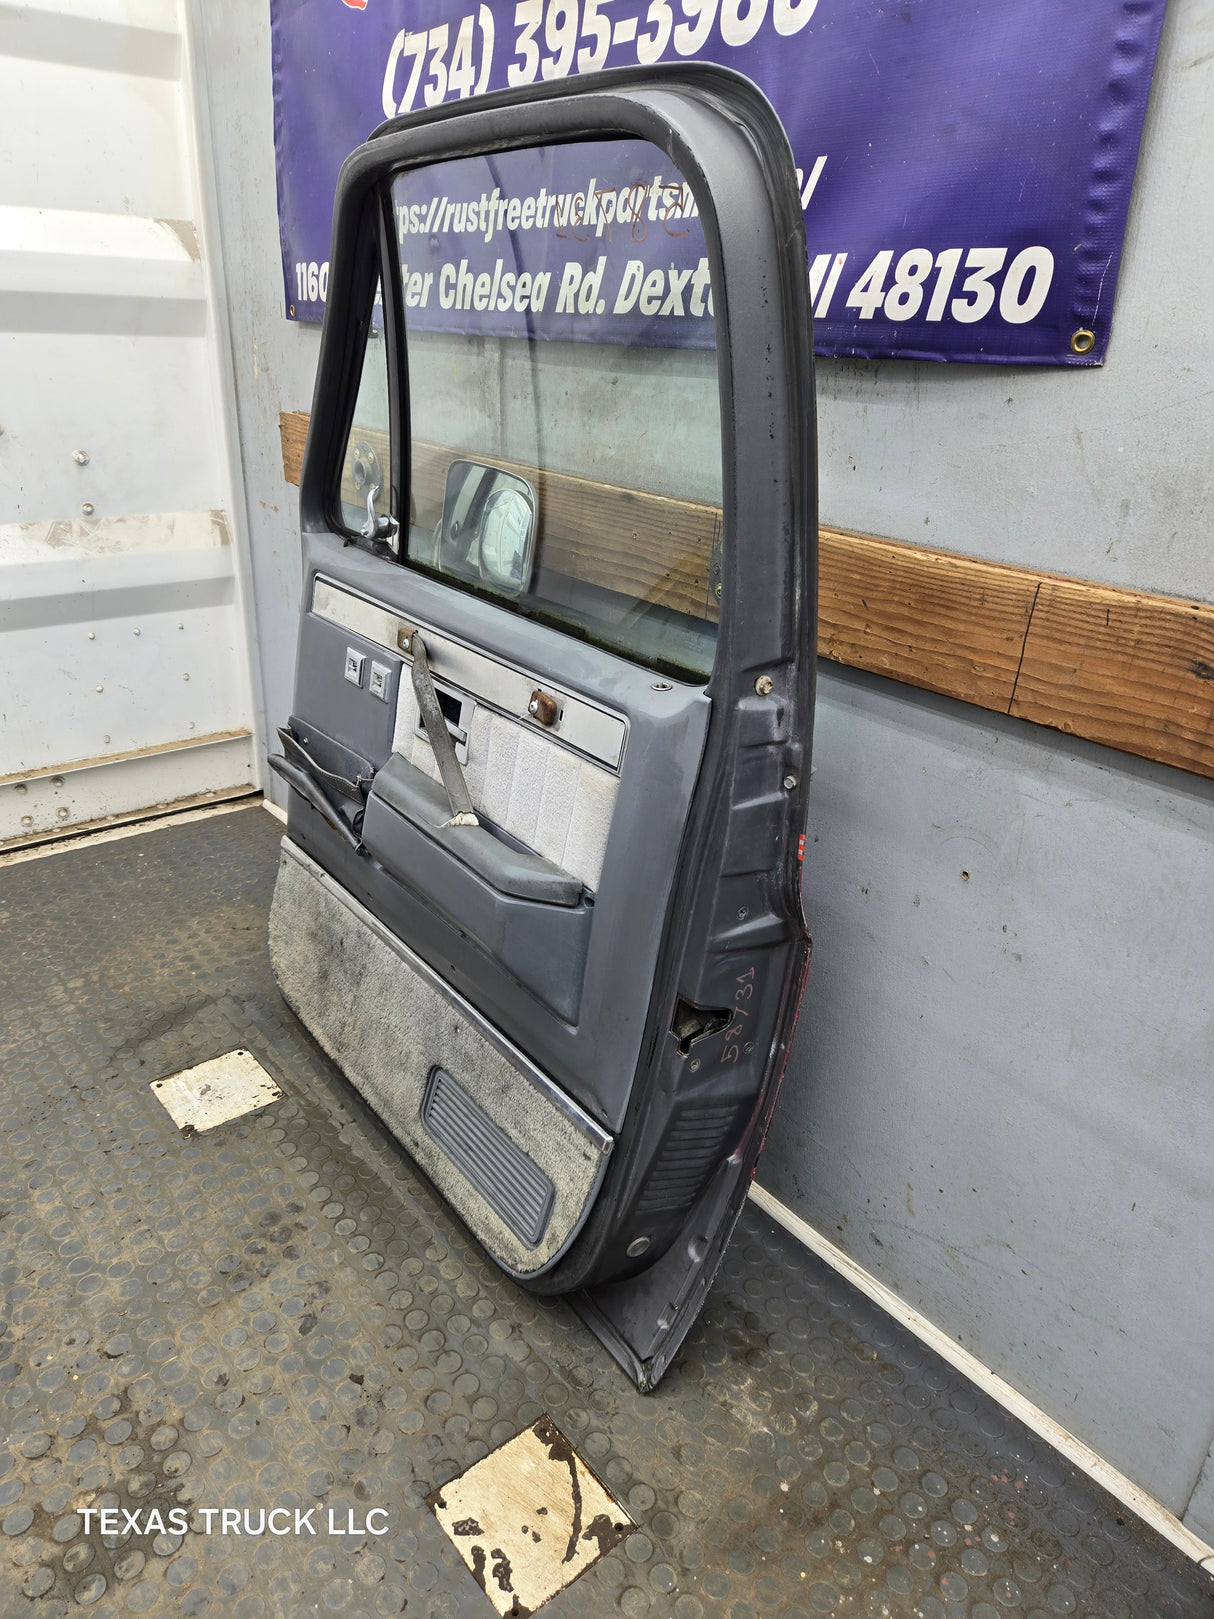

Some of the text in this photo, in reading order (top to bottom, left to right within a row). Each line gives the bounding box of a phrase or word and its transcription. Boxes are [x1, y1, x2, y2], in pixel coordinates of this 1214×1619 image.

[383, 3, 496, 118] (734)
[440, 258, 552, 311] Chelsea
[555, 256, 607, 315] Rd.
[613, 256, 715, 317] Dext
[845, 246, 1055, 324] 48130
